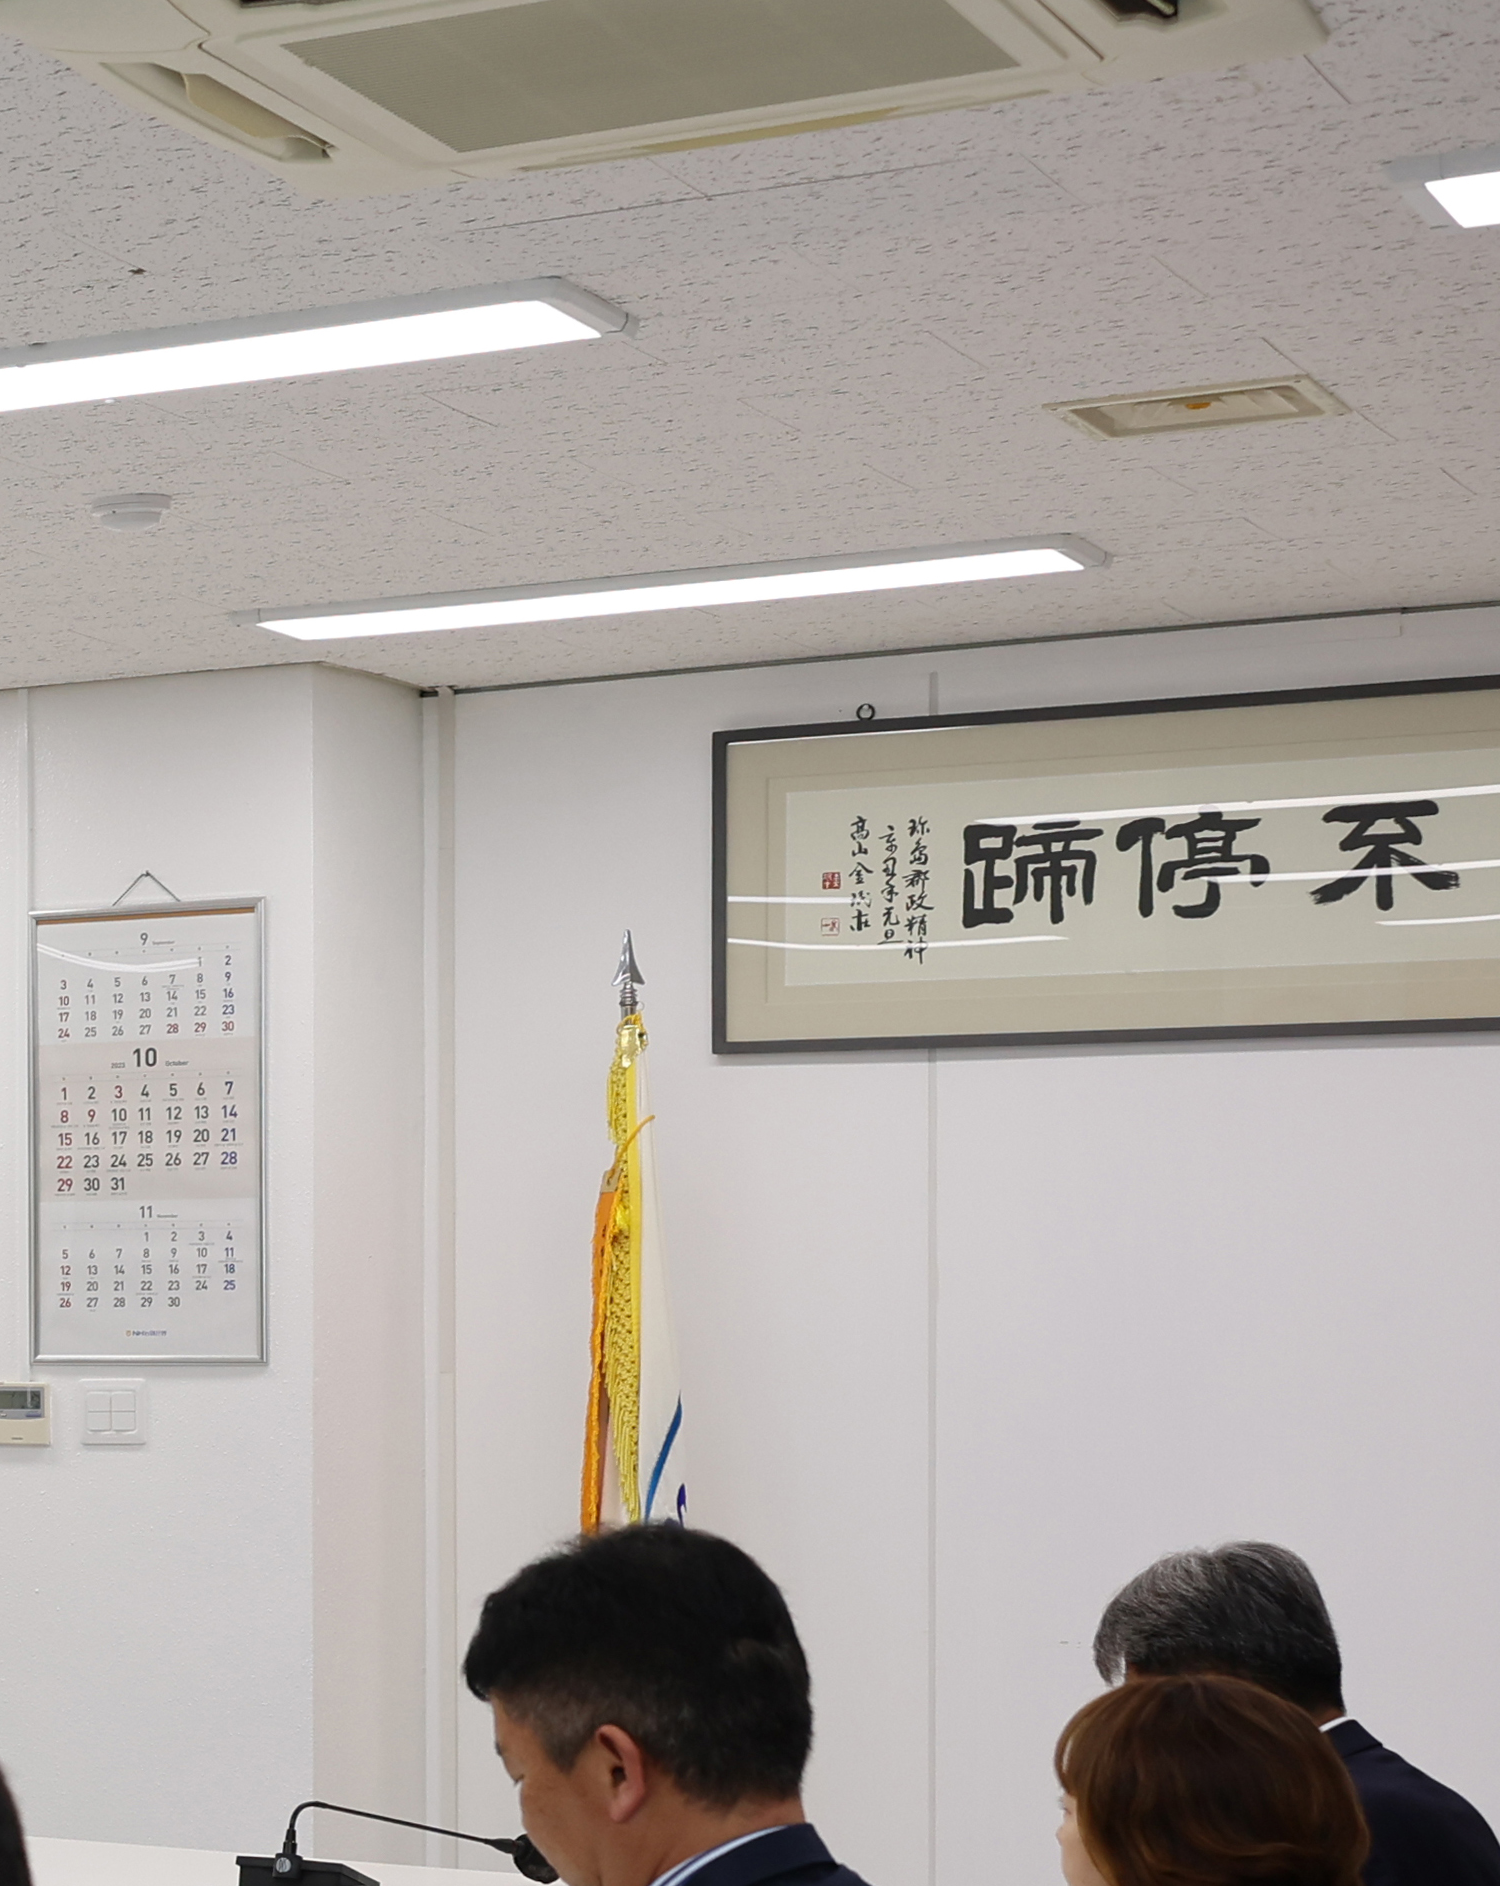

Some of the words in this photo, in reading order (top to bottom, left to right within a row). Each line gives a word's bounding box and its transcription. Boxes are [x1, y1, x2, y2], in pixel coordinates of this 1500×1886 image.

[139, 932, 149, 946] 9
[224, 954, 232, 966] 2
[60, 979, 67, 991] 3
[86, 978, 94, 989] 4
[114, 976, 121, 988] 5
[141, 975, 149, 986] 6
[168, 973, 176, 985] 7
[196, 972, 204, 984] 8
[224, 971, 232, 982] 9
[58, 995, 70, 1007] 10
[84, 994, 96, 1005] 11
[112, 992, 124, 1004] 12
[139, 991, 151, 1003] 13
[166, 990, 178, 1002] 14
[195, 988, 207, 1000] 15
[223, 987, 235, 999] 16
[58, 1011, 70, 1023] 17
[85, 1010, 97, 1022] 18
[112, 1008, 124, 1020] 19
[138, 1007, 152, 1019] 20
[166, 1006, 178, 1018] 21
[193, 1005, 207, 1017] 22
[221, 1003, 235, 1016] 23
[57, 1028, 71, 1039] 24
[84, 1026, 97, 1038] 25
[111, 1025, 124, 1037] 26
[138, 1024, 152, 1036] 27
[166, 1022, 179, 1035] 28
[194, 1021, 207, 1033] 29
[221, 1020, 235, 1032] 30
[132, 1047, 158, 1068] 10
[61, 1086, 67, 1101] 1
[87, 1085, 96, 1100] 2
[114, 1084, 123, 1099] 3
[140, 1084, 150, 1098] 4
[169, 1082, 178, 1097] 5
[196, 1081, 206, 1097] 6
[224, 1080, 234, 1095] 7
[60, 1109, 69, 1124] 8
[87, 1108, 96, 1123] 9
[111, 1107, 128, 1122] 10
[138, 1107, 151, 1122] 11
[165, 1105, 182, 1121] 12
[194, 1105, 209, 1120] 13
[221, 1104, 238, 1119] 14
[58, 1132, 73, 1147] 15
[84, 1131, 100, 1146] 16
[111, 1130, 128, 1145] 17
[137, 1130, 154, 1144] 18
[166, 1129, 183, 1144] 19
[193, 1128, 210, 1143] 20
[220, 1127, 236, 1142] 21
[56, 1155, 73, 1170] 22
[83, 1154, 100, 1169] 23
[110, 1154, 127, 1168] 24
[136, 1152, 154, 1168] 25
[164, 1152, 182, 1167] 26
[192, 1151, 210, 1166] 27
[220, 1150, 238, 1166] 28
[57, 1177, 74, 1193] 29
[83, 1177, 101, 1192] 30
[110, 1176, 125, 1191] 31
[139, 1205, 153, 1219] 11
[144, 1231, 149, 1243] 1
[170, 1230, 178, 1242] 2
[198, 1230, 205, 1242] 3
[225, 1230, 233, 1241] 4
[62, 1248, 69, 1260] 5
[88, 1248, 96, 1260] 6
[115, 1248, 123, 1259] 7
[142, 1247, 150, 1259] 8
[170, 1247, 178, 1258] 9
[196, 1247, 208, 1258] 10
[224, 1246, 234, 1258] 11
[60, 1265, 72, 1276] 12
[86, 1264, 98, 1276] 13
[113, 1264, 126, 1275] 14
[141, 1263, 153, 1275] 15
[168, 1263, 180, 1275] 16
[196, 1263, 208, 1275] 17
[224, 1263, 236, 1274] 18
[60, 1281, 72, 1292] 19
[86, 1280, 99, 1292] 20
[113, 1280, 125, 1292] 21
[140, 1280, 153, 1292] 22
[167, 1279, 181, 1291] 23
[195, 1279, 208, 1291] 24
[223, 1279, 236, 1291] 25
[59, 1297, 72, 1308] 26
[86, 1296, 99, 1308] 27
[113, 1296, 126, 1308] 28
[140, 1296, 153, 1308] 29
[167, 1296, 181, 1308] 30
